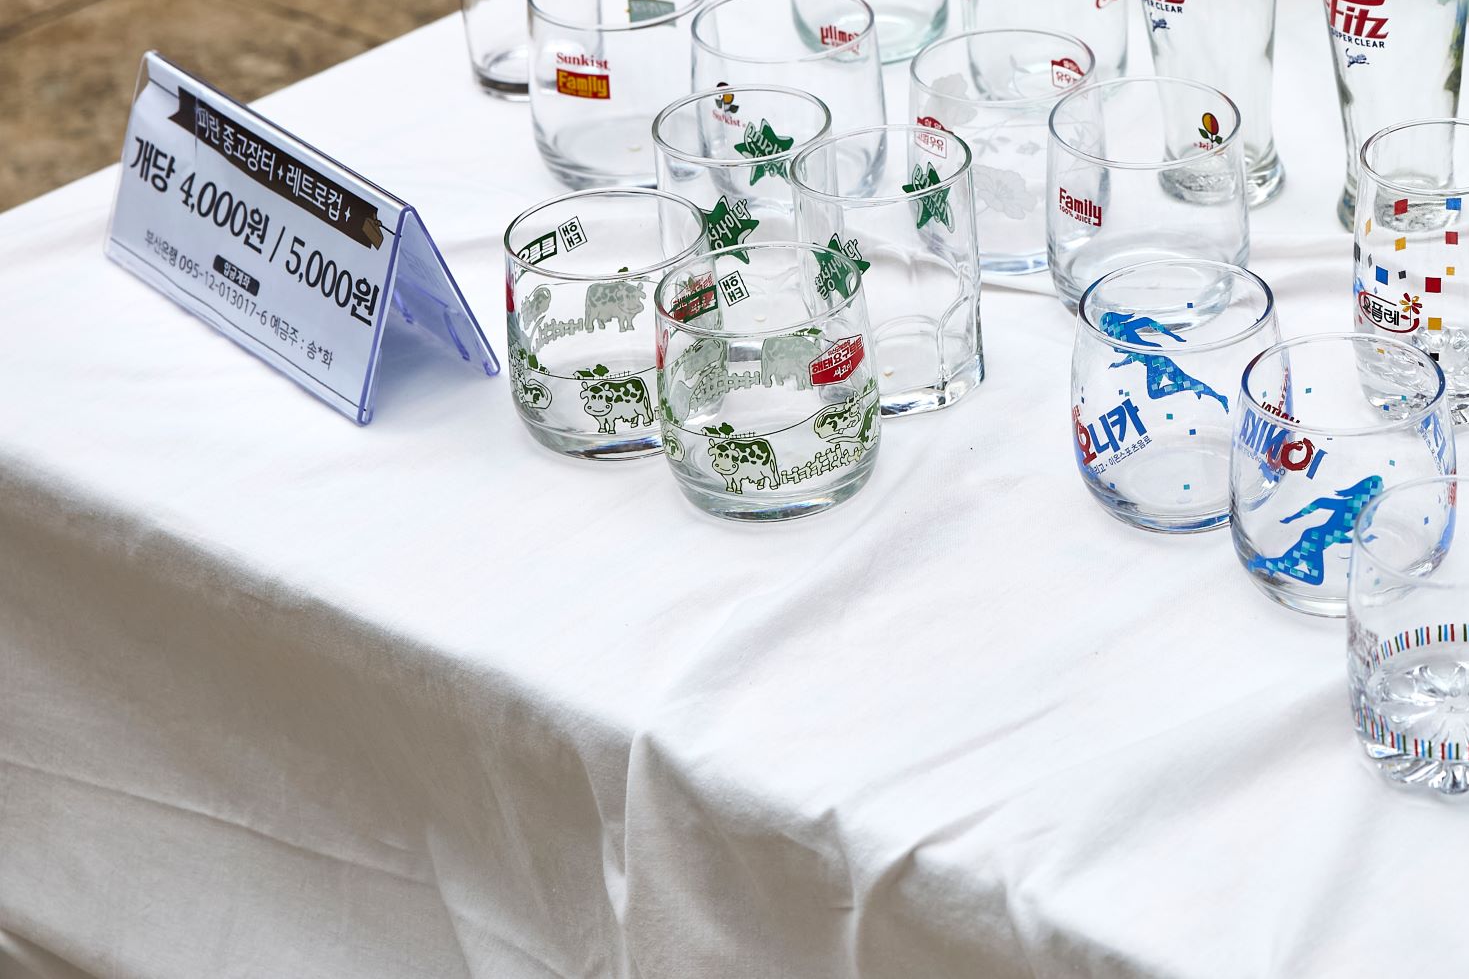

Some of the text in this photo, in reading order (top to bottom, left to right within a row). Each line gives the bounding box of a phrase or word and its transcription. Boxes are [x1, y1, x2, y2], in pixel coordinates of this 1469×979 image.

[1155, 2, 1183, 13] CLEAR
[1354, 37, 1385, 48] CLEAR
[556, 52, 608, 70] Sunkist
[559, 71, 608, 97] Family
[198, 106, 343, 221] 피란 중고장터 레트로컵
[1059, 187, 1102, 227] Family
[1074, 214, 1092, 225] JUICE
[130, 136, 176, 193] 개당
[180, 172, 271, 255] 4,000원
[285, 236, 380, 327] 5,000원
[144, 230, 178, 267] 부산은행
[178, 254, 268, 326] 095-12-013017-6
[269, 314, 299, 347] 예금주
[1363, 296, 1399, 326] 요플레
